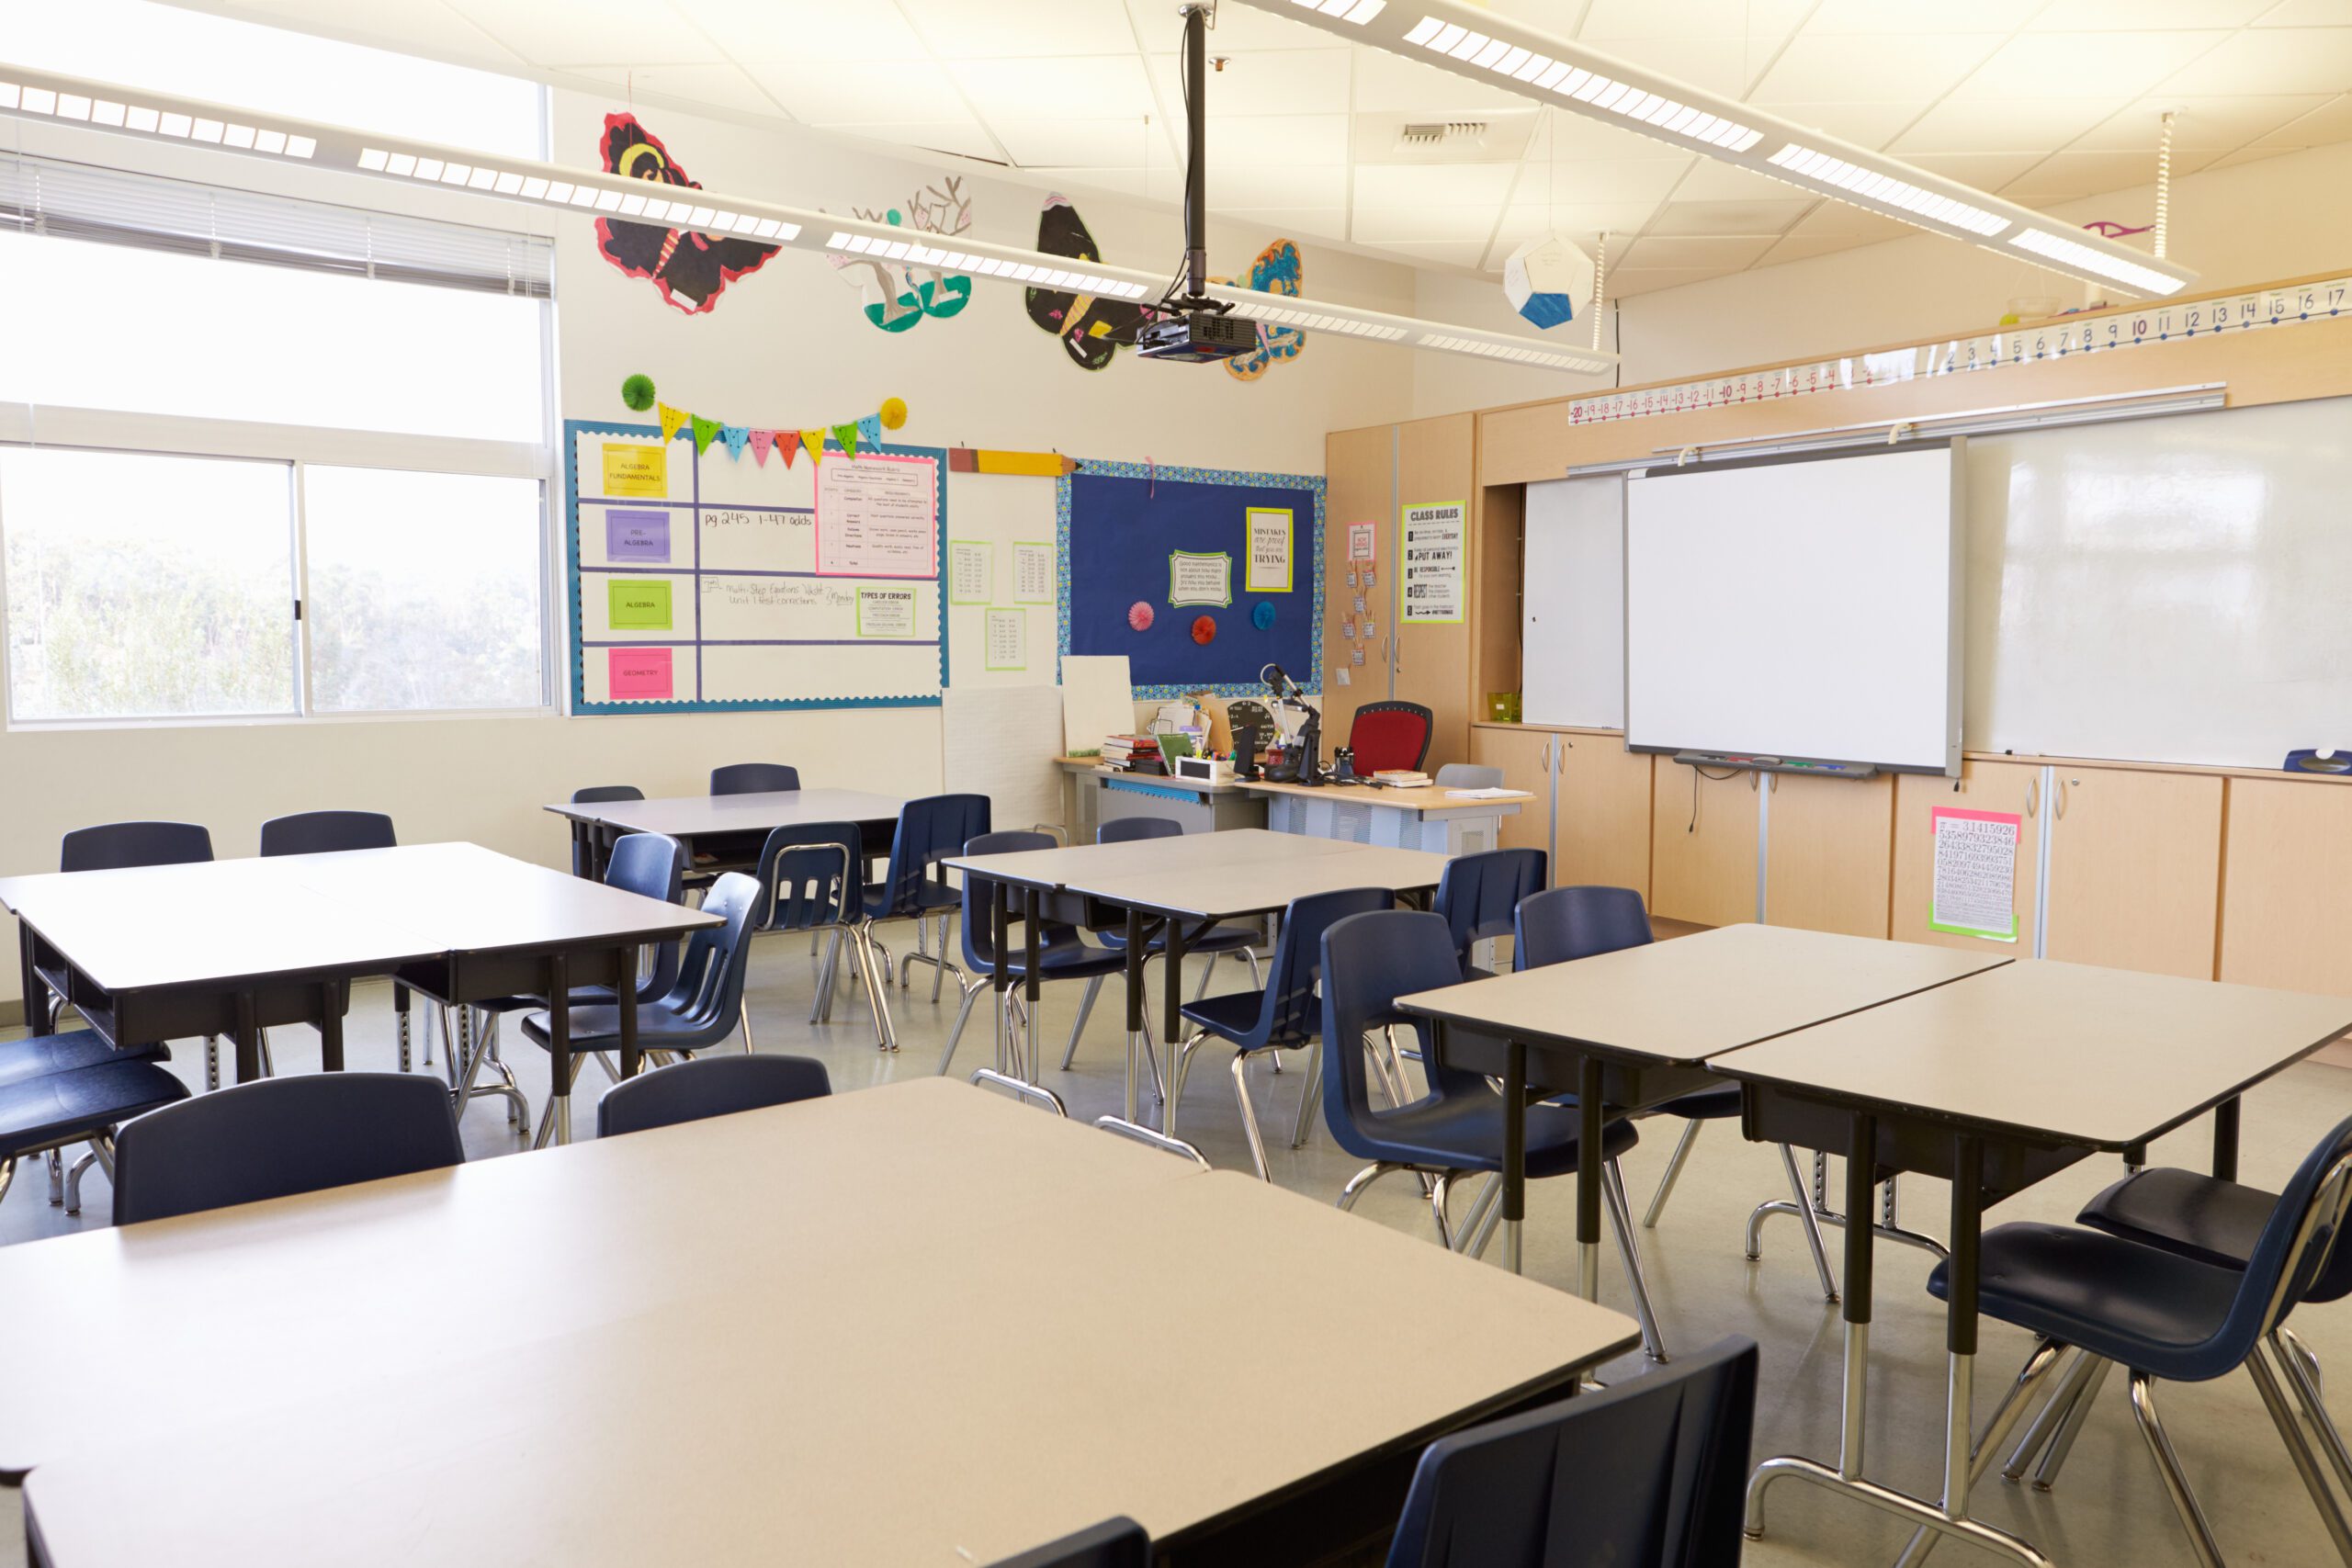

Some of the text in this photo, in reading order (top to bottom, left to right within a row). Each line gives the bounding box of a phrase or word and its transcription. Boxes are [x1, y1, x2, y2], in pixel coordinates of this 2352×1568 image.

[1570, 406, 1583, 418] -20
[1584, 404, 1595, 415] -19
[1598, 402, 1609, 413] -18
[1611, 400, 1623, 412] -17
[1626, 399, 1638, 411] -16
[1641, 397, 1654, 408] -15
[1656, 394, 1668, 406] -14
[1671, 392, 1684, 404] -13
[1687, 390, 1699, 402] -12
[1702, 388, 1714, 400] -11
[1719, 385, 1732, 398] -10
[1736, 383, 1747, 395] -9
[1752, 381, 1763, 392] -8
[1771, 378, 1781, 390] -7
[1789, 375, 1798, 388] -6
[1806, 372, 1816, 385] -5
[1825, 369, 1835, 382] -4
[1947, 352, 1955, 365] 2
[1968, 347, 1975, 361] 3
[2013, 340, 2021, 355] 5
[2036, 336, 2045, 351] 6
[2060, 333, 2069, 347] 7
[2084, 329, 2092, 344] 8
[2109, 324, 2118, 339] 9
[2132, 320, 2147, 336] 10
[2159, 316, 2170, 331] 11
[2185, 311, 2199, 328] 12
[2212, 308, 2228, 323] 13
[2241, 303, 2256, 319] 14
[2269, 299, 2285, 315] 15
[2298, 294, 2314, 311] 16
[2328, 289, 2346, 306] 17
[609, 473, 661, 481] FUNDAMENTALS
[705, 513, 718, 527] pg
[721, 512, 750, 525] 245
[759, 514, 786, 525] 1-47
[1410, 509, 1458, 521] CLASS RULES
[1255, 555, 1285, 563] TRYING
[1419, 551, 1452, 560] PUT AWAY!
